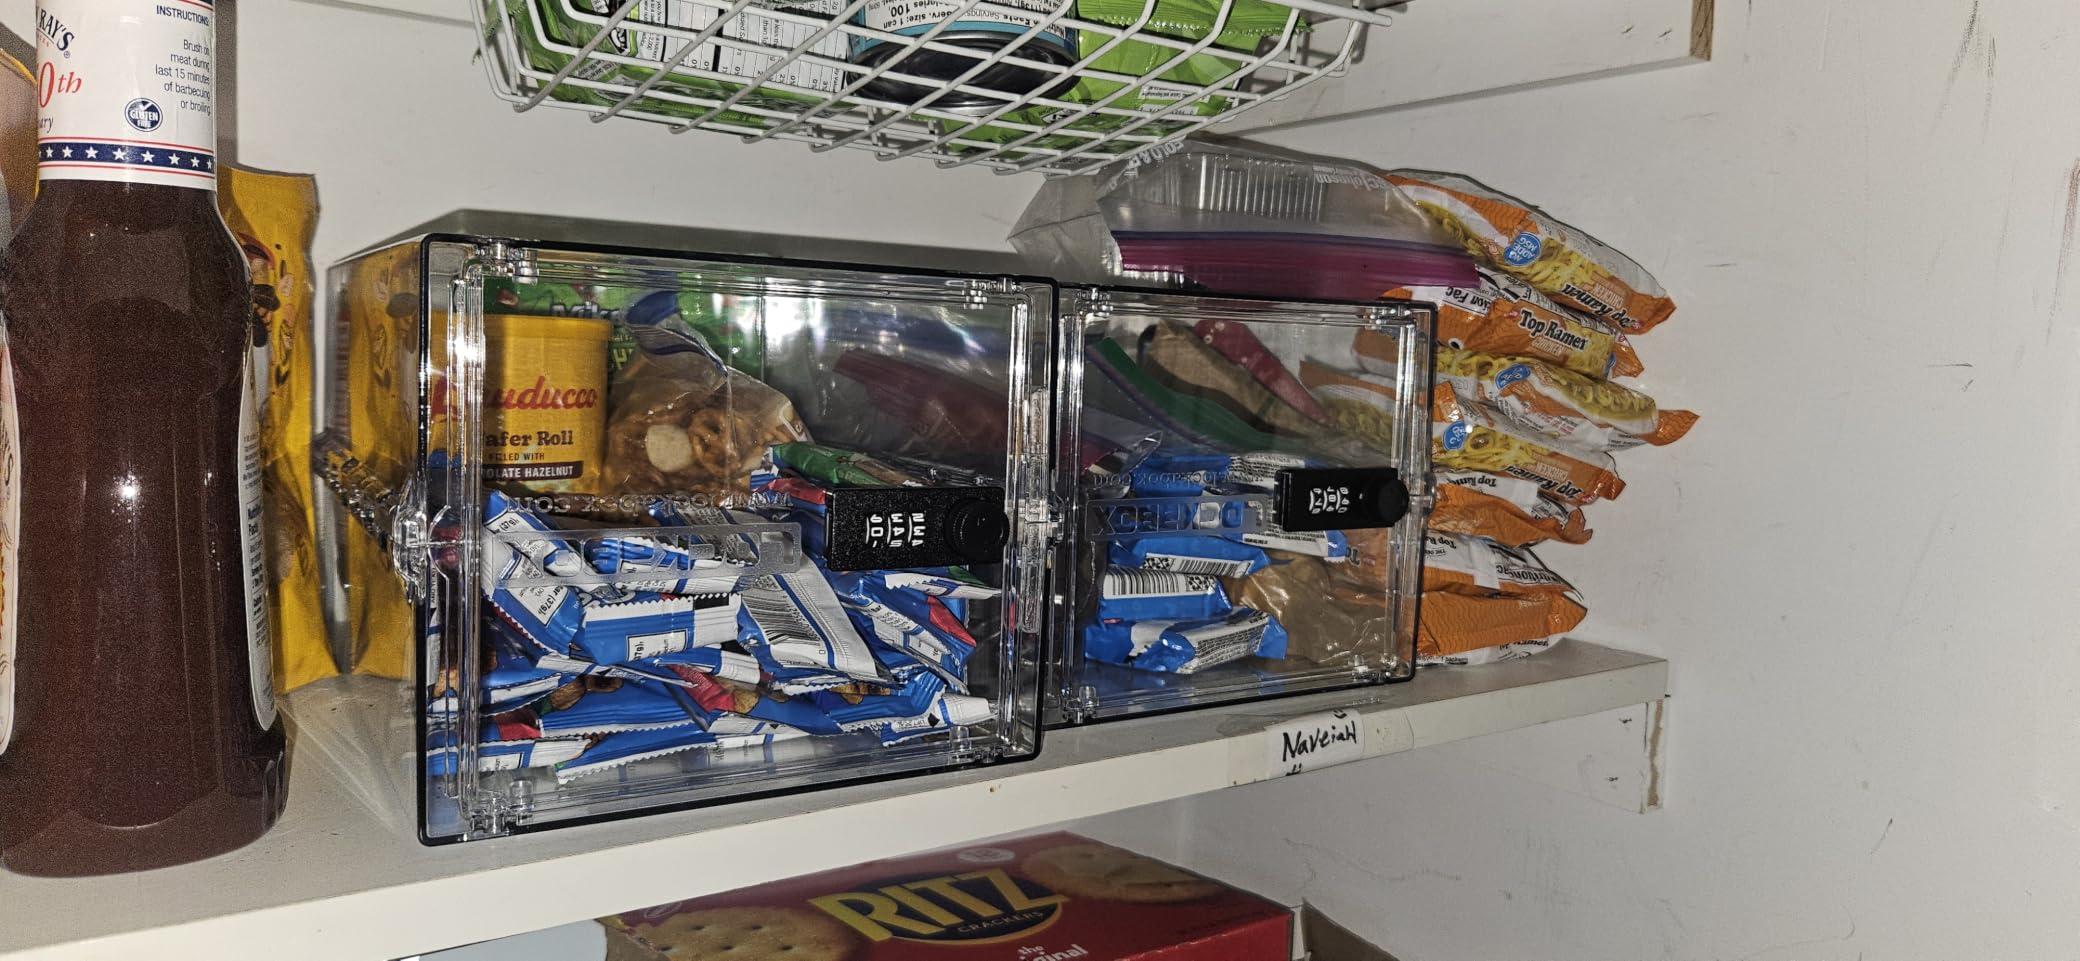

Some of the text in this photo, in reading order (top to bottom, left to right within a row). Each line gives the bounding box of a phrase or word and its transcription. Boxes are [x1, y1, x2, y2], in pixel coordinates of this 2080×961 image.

[884, 19, 897, 29] can
[183, 39, 203, 53] Brush
[170, 53, 191, 66] meat
[155, 64, 172, 77] last
[175, 67, 186, 79] 15
[164, 82, 173, 92] of
[180, 101, 189, 110] or
[130, 110, 159, 122] GLUTEN
[1512, 243, 1536, 259] ADDE
[1561, 284, 1613, 317] Ramen
[1519, 309, 1546, 337] Top
[536, 430, 575, 447] Roll
[523, 451, 546, 462] WITH
[524, 465, 574, 478] HAZELNUT
[1503, 465, 1557, 491] Ramen
[1478, 475, 1498, 488] Top
[1437, 537, 1457, 549] Top
[806, 867, 1070, 942] RITZ
[957, 910, 1025, 934] CRACKERS
[1018, 945, 1044, 957] the
